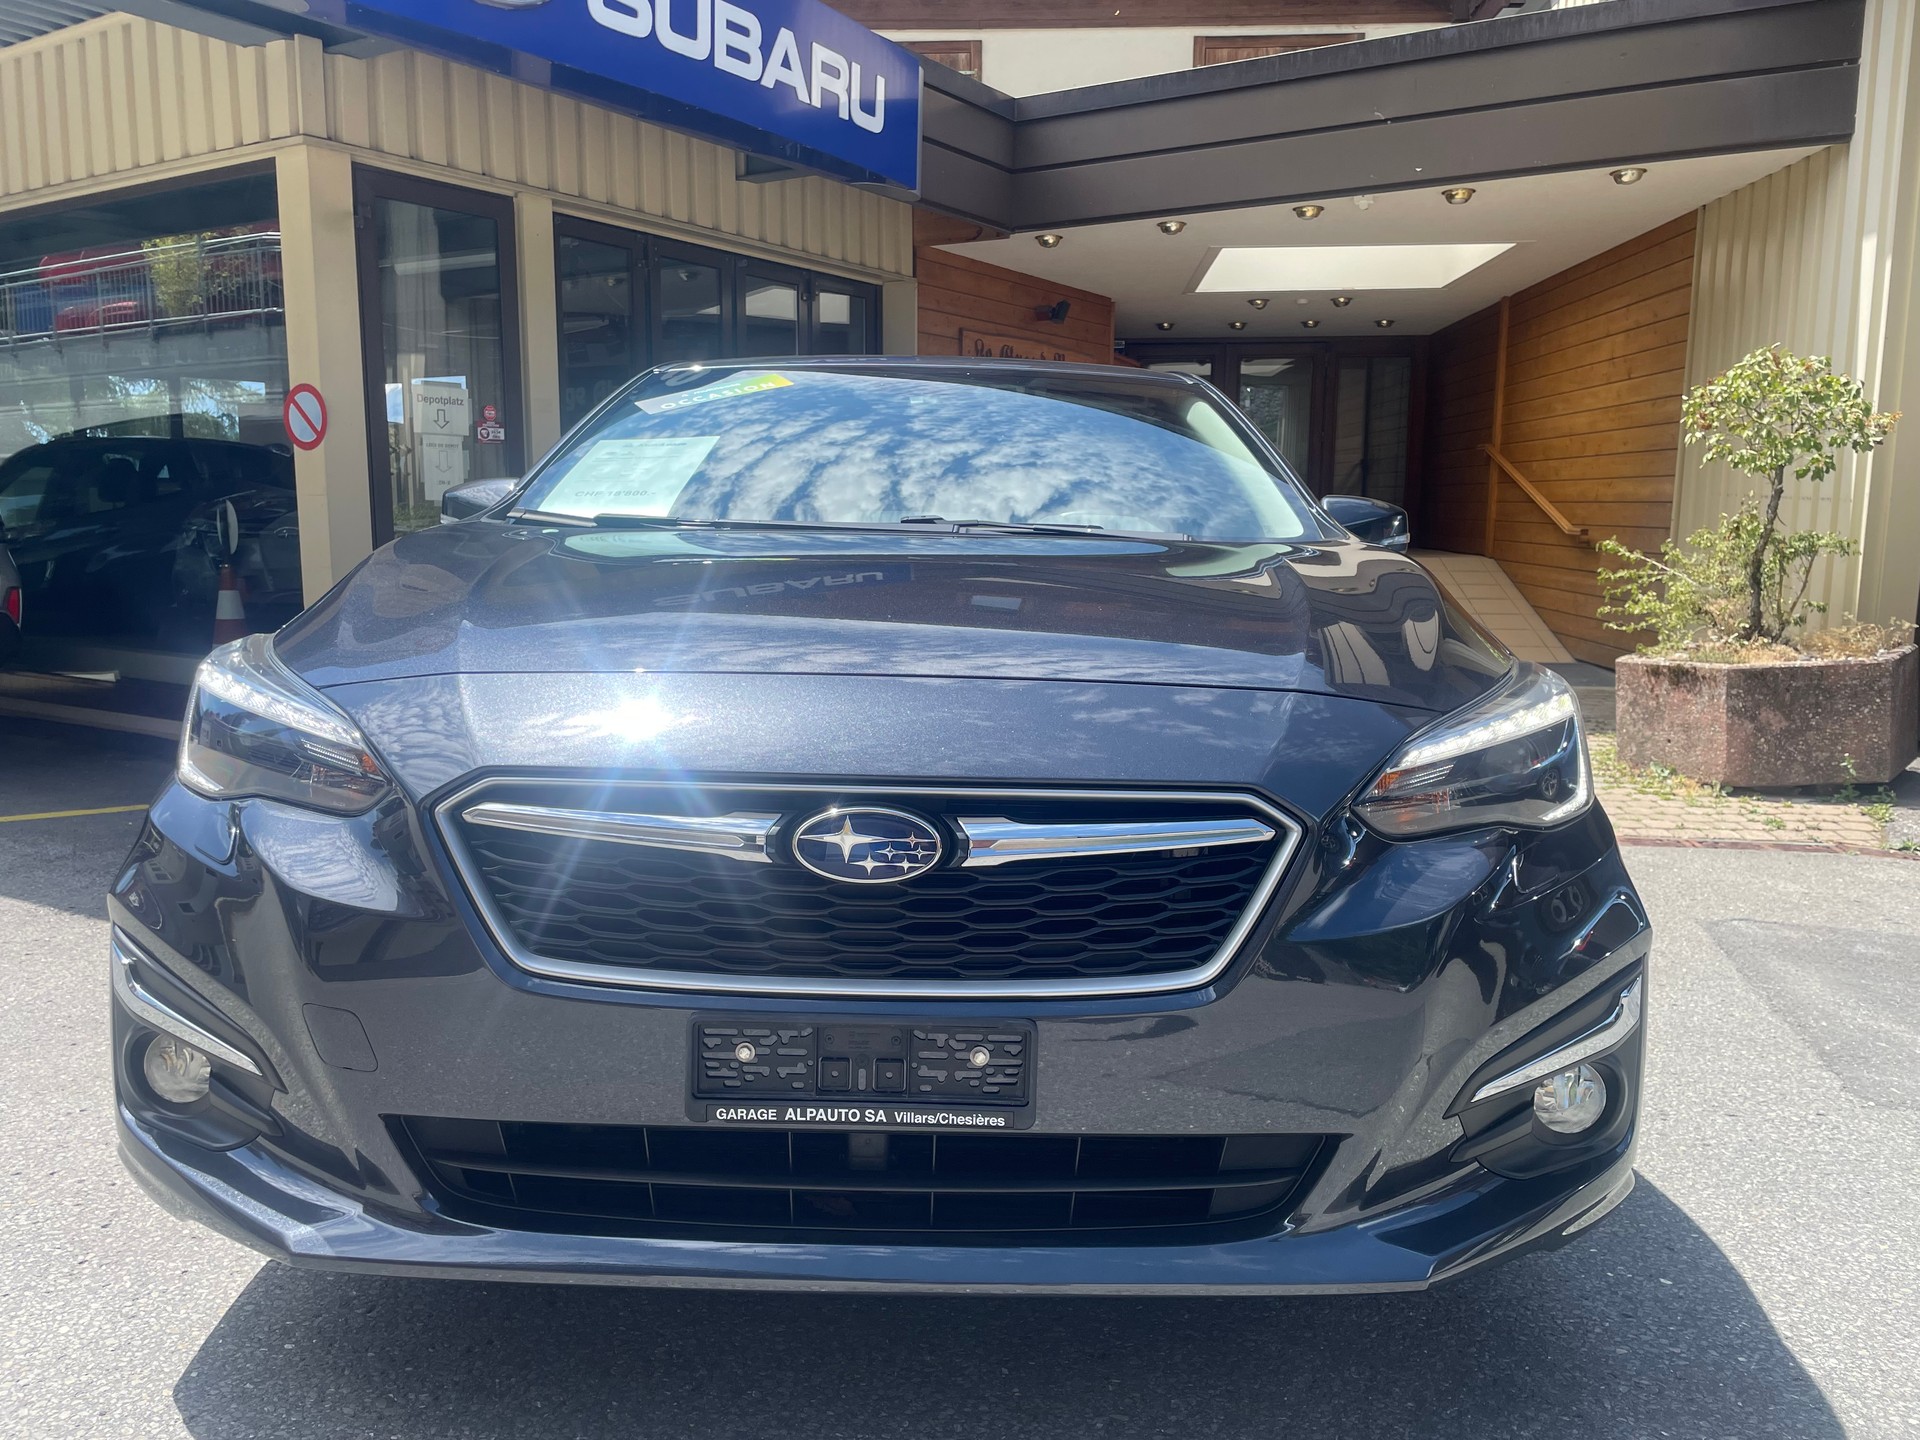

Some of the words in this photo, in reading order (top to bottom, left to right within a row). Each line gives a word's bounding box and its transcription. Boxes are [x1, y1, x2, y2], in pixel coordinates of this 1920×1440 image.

[587, 0, 886, 134] SUBARU
[416, 393, 465, 407] Depotplatz
[660, 382, 776, 409] OCCASION
[715, 1108, 778, 1121] GARAGE
[785, 1108, 861, 1122] ALPAUTO
[864, 1112, 887, 1123] SA
[894, 1111, 1006, 1127] Villars/Chesières
